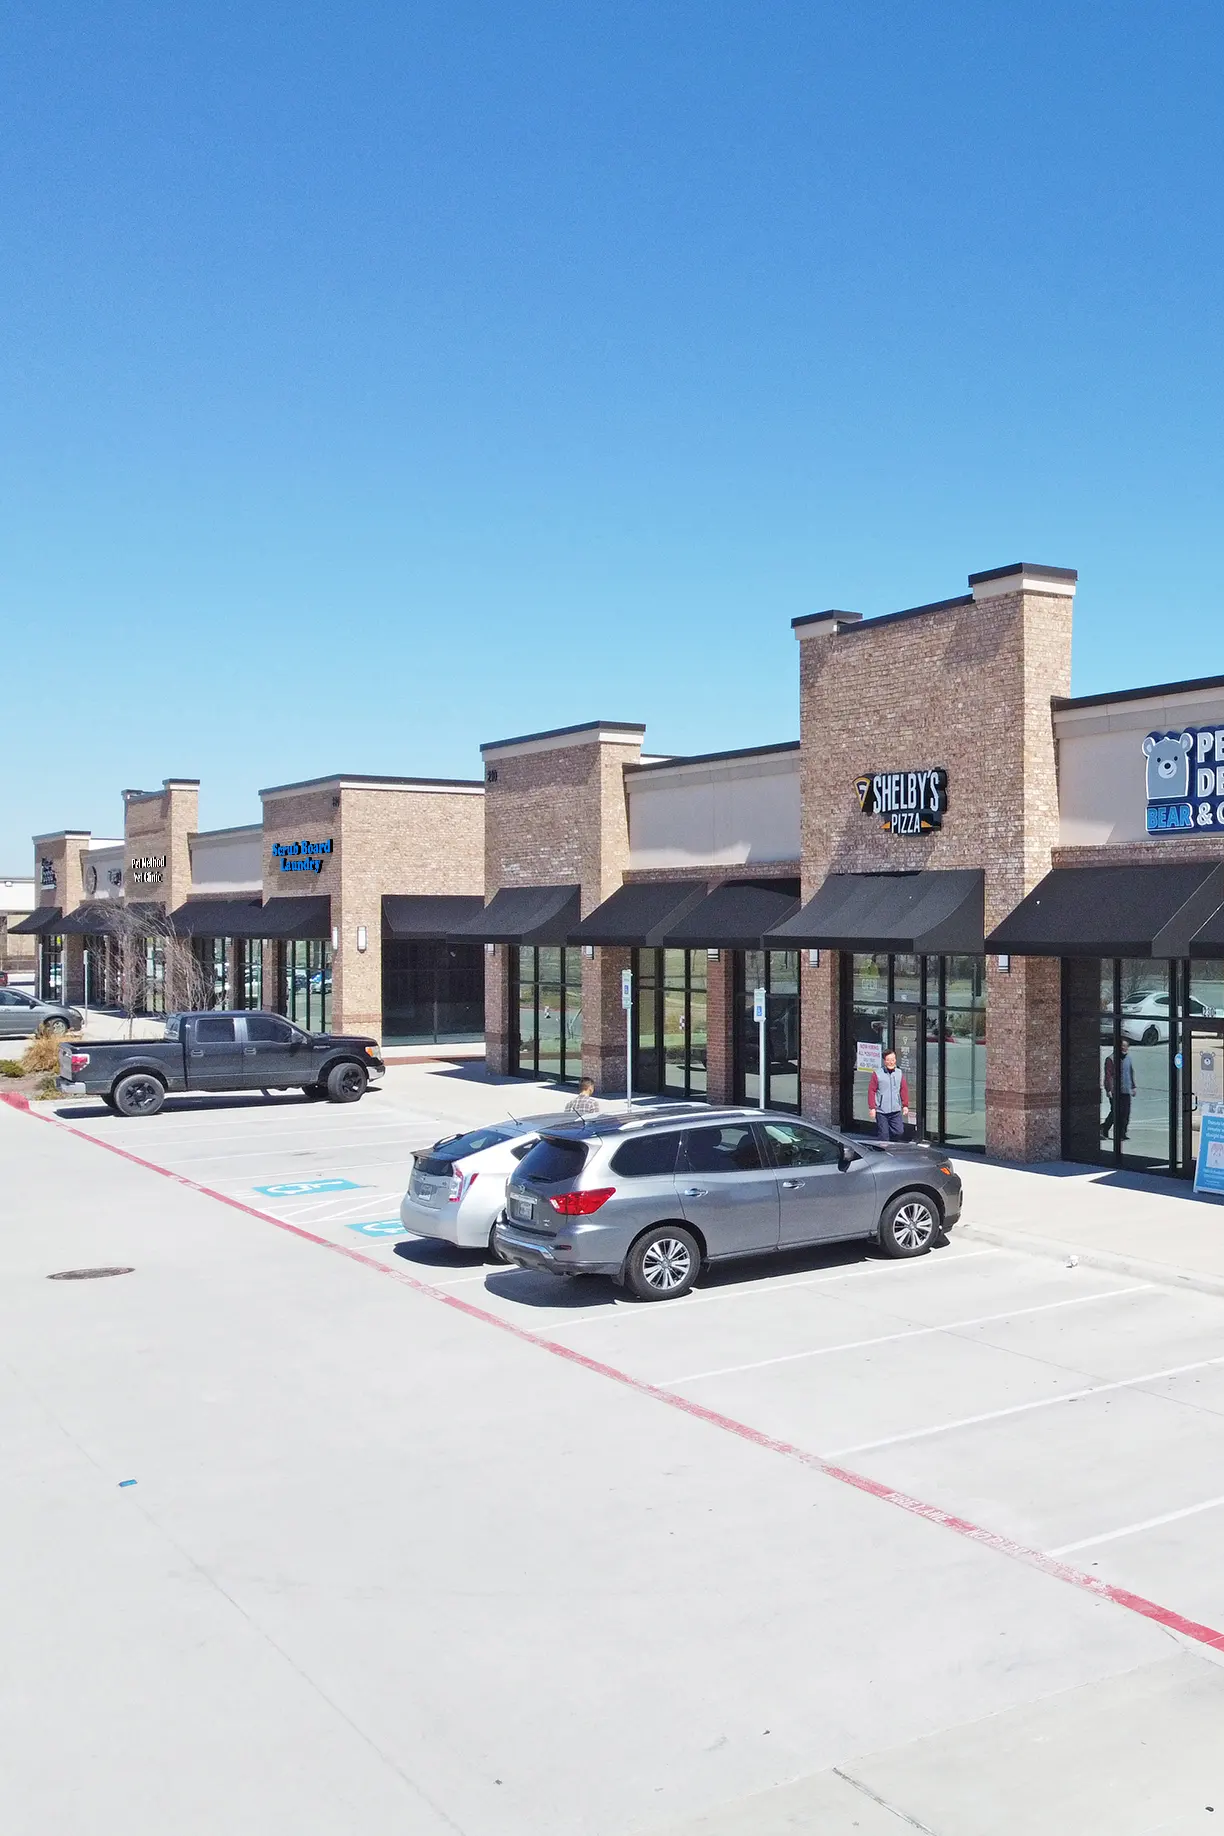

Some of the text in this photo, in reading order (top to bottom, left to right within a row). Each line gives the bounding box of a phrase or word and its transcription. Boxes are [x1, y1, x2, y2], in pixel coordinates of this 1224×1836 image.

[873, 770, 939, 814] SHELBY'S
[891, 812, 920, 834] PIZZA
[1147, 805, 1192, 829] BEAR
[1196, 802, 1213, 826] &
[272, 838, 333, 857] Scrub Board
[280, 857, 323, 873] Laundry
